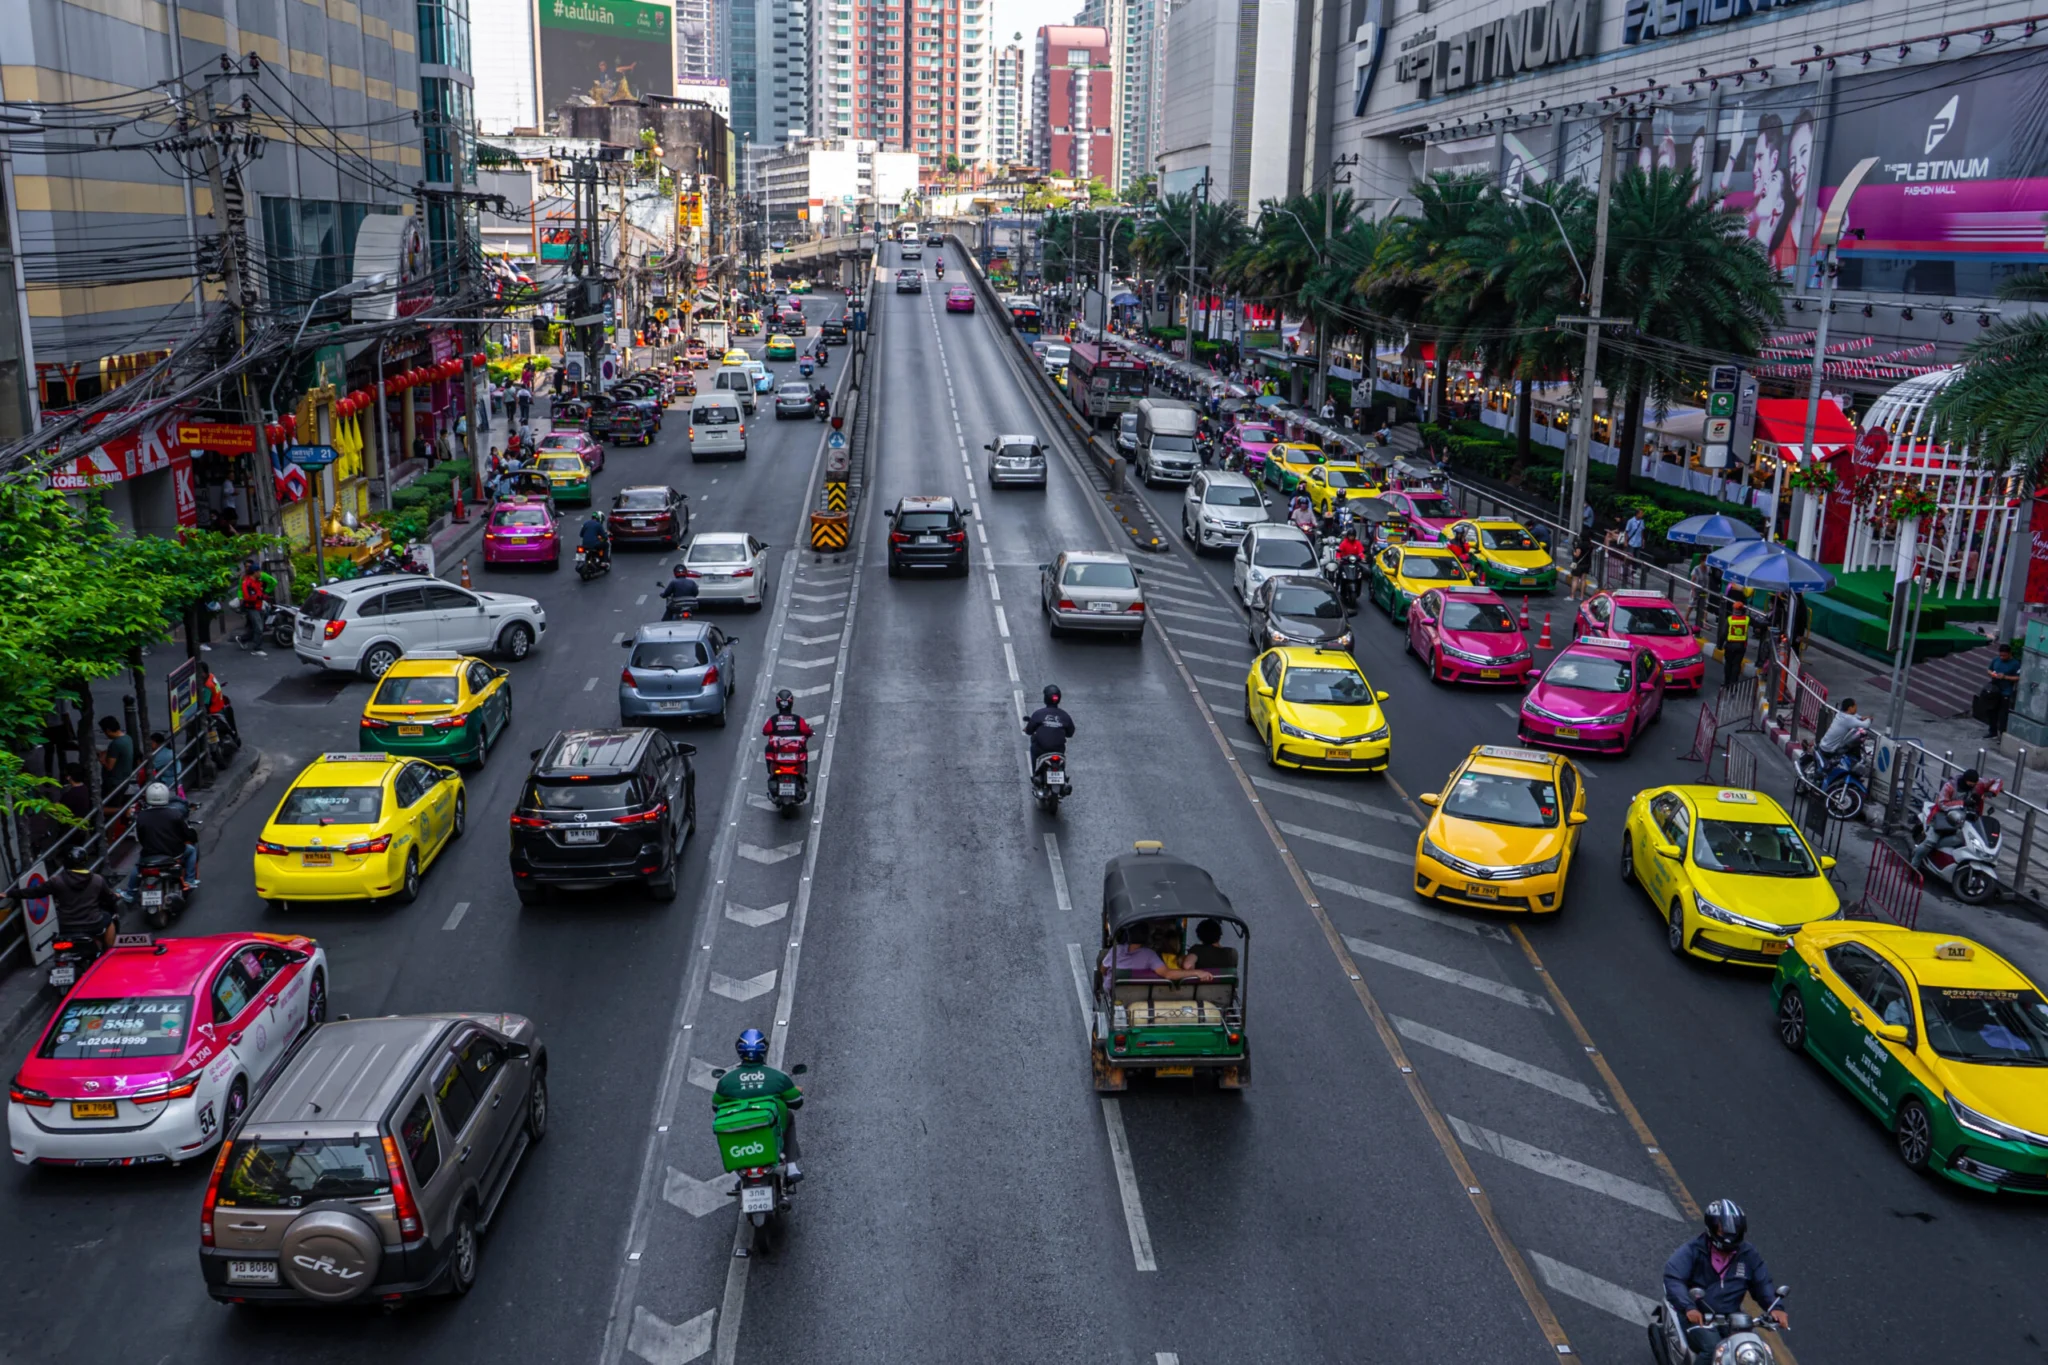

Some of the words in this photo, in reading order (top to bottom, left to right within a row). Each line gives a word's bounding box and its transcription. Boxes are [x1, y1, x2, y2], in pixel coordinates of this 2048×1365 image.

[1904, 186, 1935, 195] FASHION
[1935, 185, 1956, 194] MALL
[321, 449, 331, 459] 21
[1730, 787, 1748, 800] TAXI
[1948, 948, 1966, 957] TAXI
[65, 1004, 131, 1018] SMART
[136, 1003, 185, 1013] TAXI
[103, 1019, 145, 1029] 5858
[739, 1070, 765, 1082] Grab
[200, 1107, 217, 1135] 54
[730, 1142, 764, 1158] Grab
[249, 1261, 274, 1272] 8080
[293, 1255, 363, 1279] CR-V
